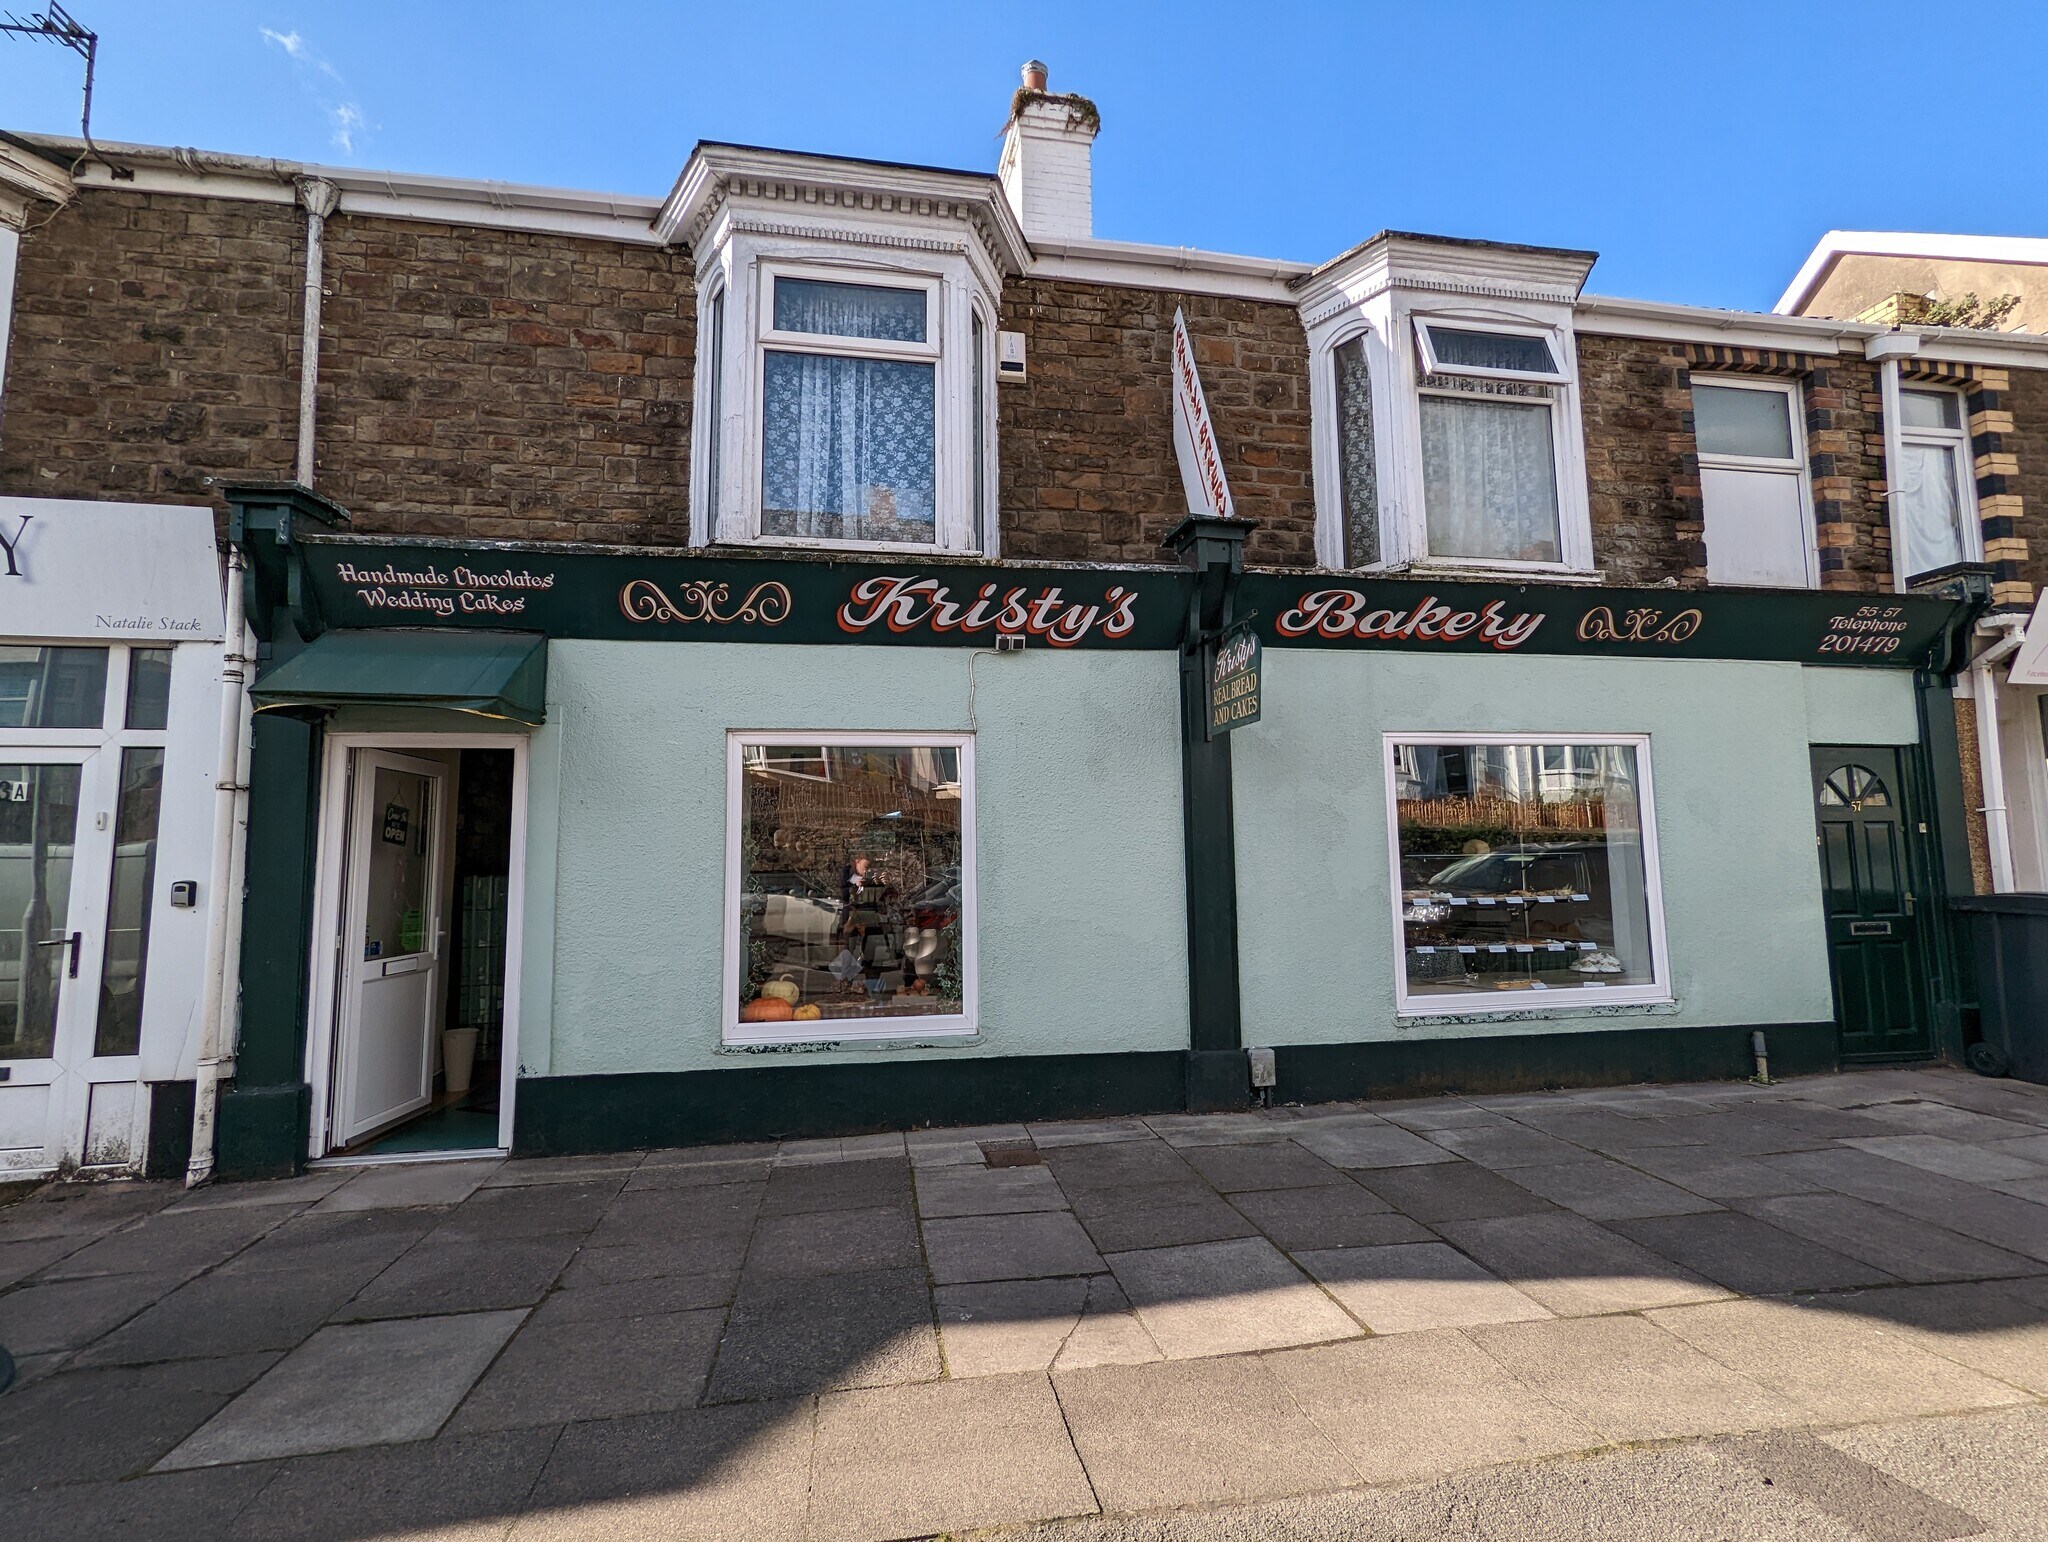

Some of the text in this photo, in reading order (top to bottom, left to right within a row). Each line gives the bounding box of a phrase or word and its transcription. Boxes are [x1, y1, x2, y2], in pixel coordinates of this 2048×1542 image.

[1199, 420, 1227, 518] BAKERY
[337, 563, 556, 588] Handmade Chocolates
[357, 587, 525, 616] Wedding Cakes
[838, 575, 1138, 646] Kristy's
[95, 615, 202, 631] Natalie Stack
[1275, 589, 1546, 650] Bakery
[1829, 616, 1907, 633] Telephone
[1818, 634, 1900, 654] 201479
[1213, 673, 1257, 706] REAL BREAD
[1213, 695, 1258, 727] AND CAKES
[1851, 800, 1862, 812] 57
[385, 826, 405, 842] OPEN
